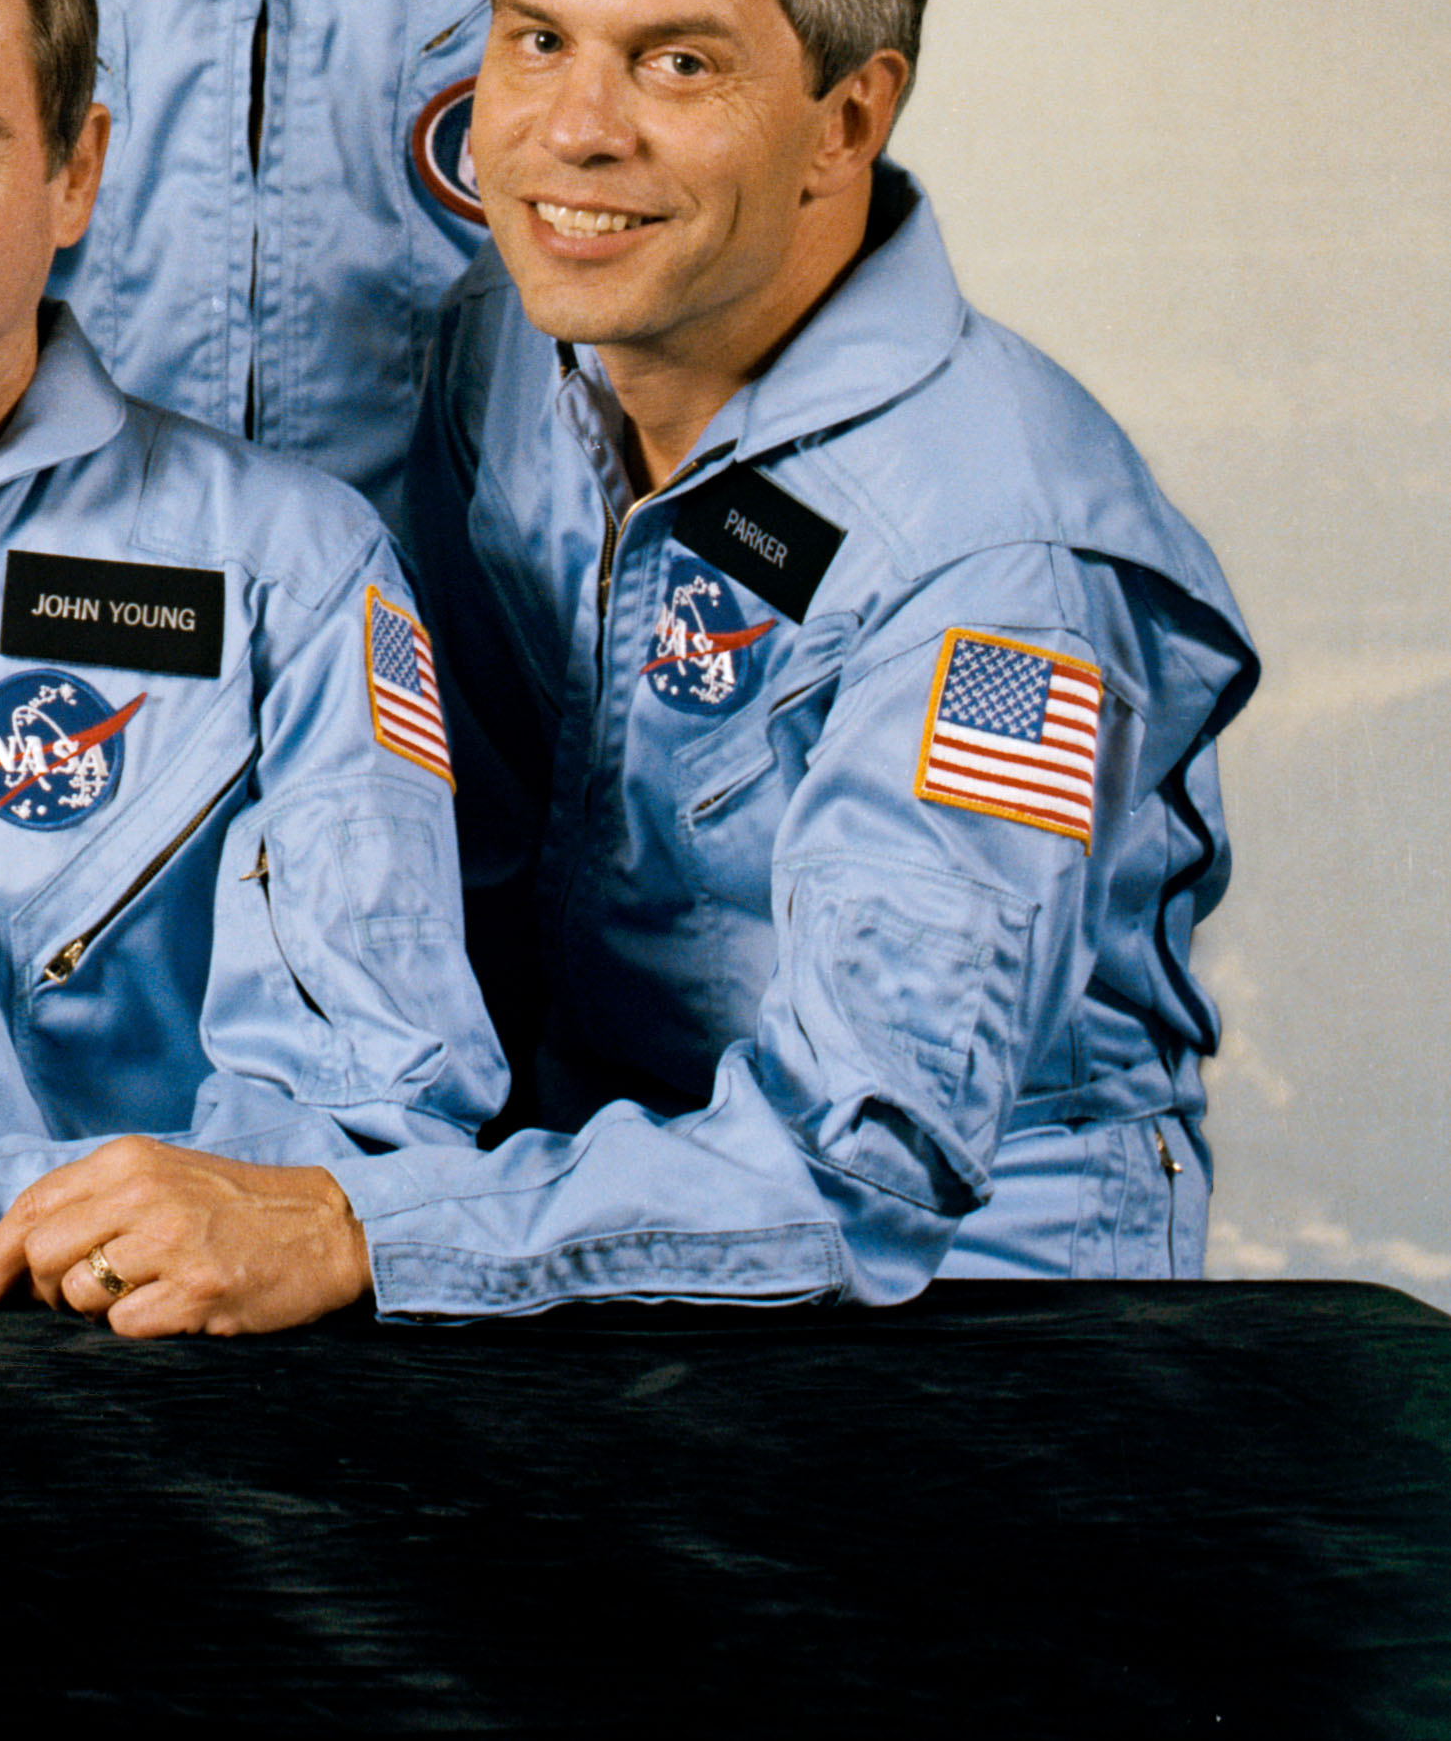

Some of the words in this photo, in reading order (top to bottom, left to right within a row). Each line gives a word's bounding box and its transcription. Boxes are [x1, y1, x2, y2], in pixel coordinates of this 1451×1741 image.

[723, 508, 789, 570] PARKER
[31, 593, 100, 623] JOHN
[109, 600, 196, 632] YOUNG
